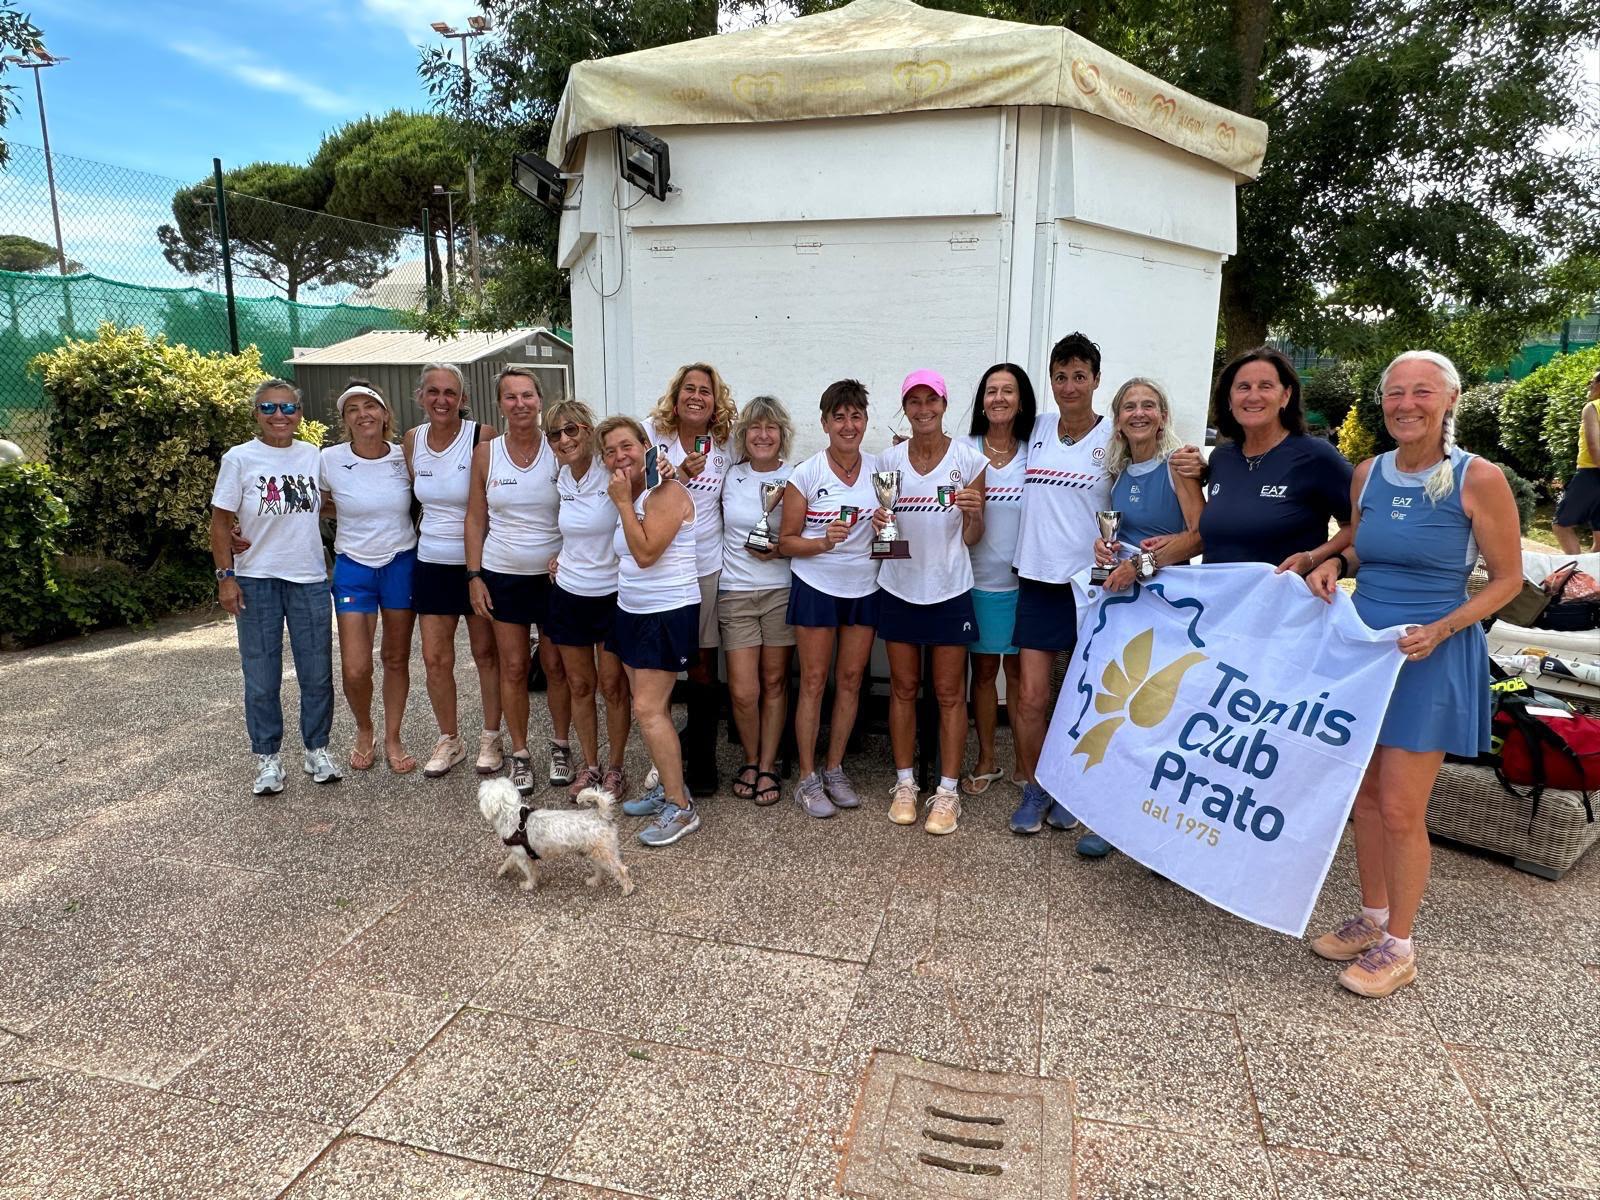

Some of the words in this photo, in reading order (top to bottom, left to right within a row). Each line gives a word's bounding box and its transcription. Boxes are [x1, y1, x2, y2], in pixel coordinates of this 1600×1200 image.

[1260, 485, 1288, 496] EA7
[1392, 496, 1413, 506] EA7
[1178, 712, 1279, 780] Club
[1149, 750, 1285, 842] Prato
[1142, 798, 1170, 824] dal
[1176, 812, 1221, 847] 1975
